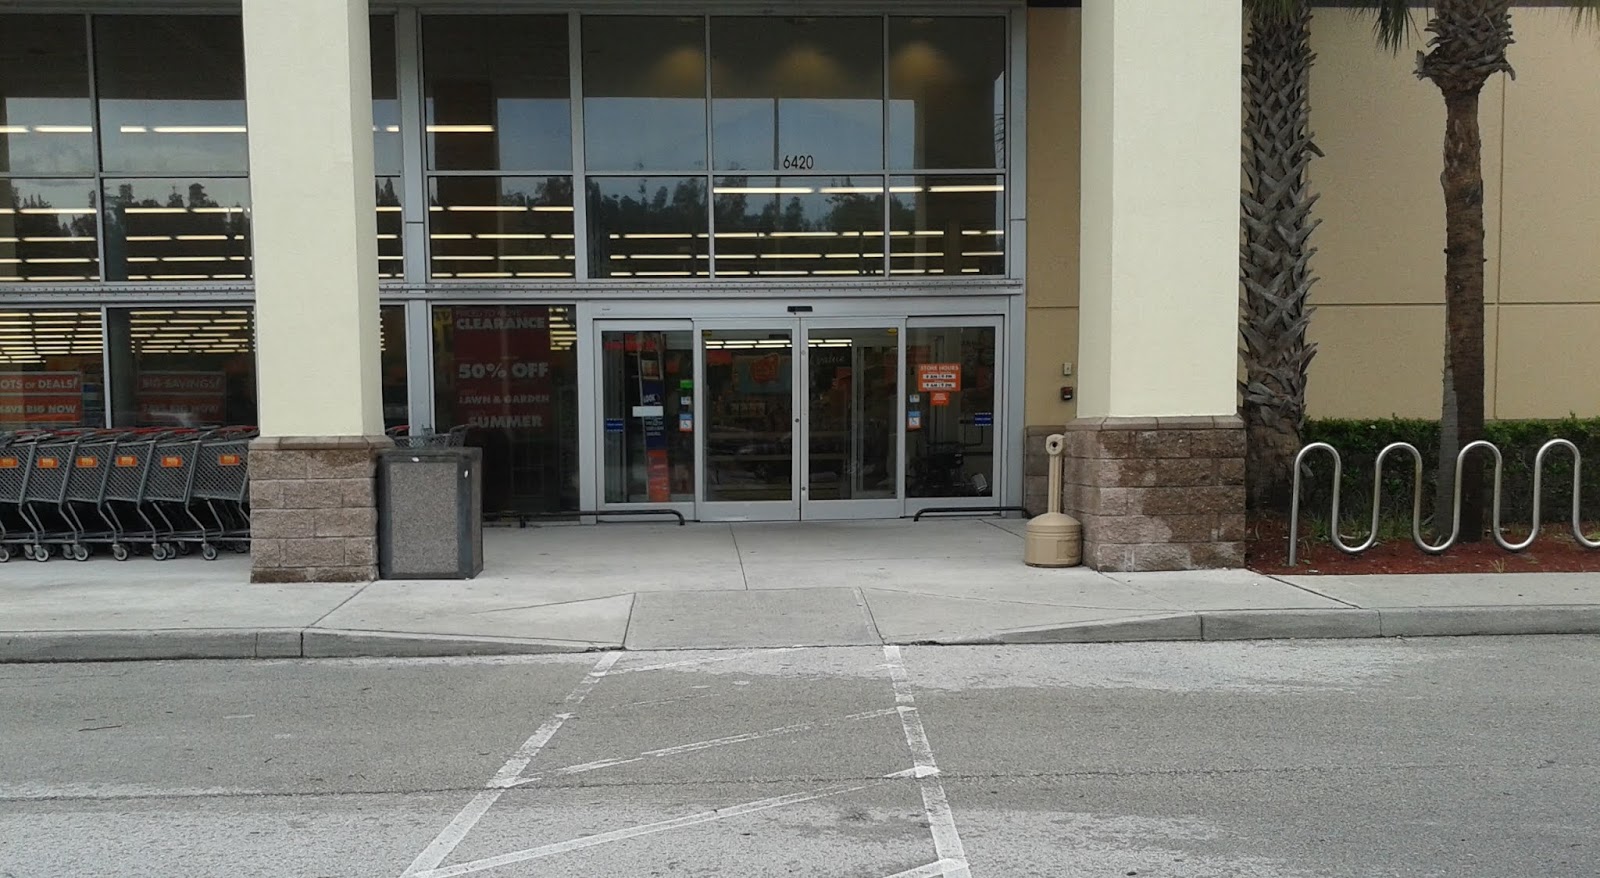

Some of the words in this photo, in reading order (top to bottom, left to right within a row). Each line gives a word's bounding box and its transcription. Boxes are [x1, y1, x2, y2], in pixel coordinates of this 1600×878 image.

[783, 154, 814, 170] 6420
[456, 317, 545, 330] CLEARANCE
[458, 362, 507, 379] 50%
[511, 362, 549, 378] OFF
[38, 377, 78, 389] DEALS!
[458, 394, 491, 404] LAWN
[493, 394, 502, 403] &
[503, 394, 550, 404] GARDEN
[26, 404, 45, 413] BIG
[48, 404, 76, 413] NOW
[468, 415, 543, 429] SUMMER
